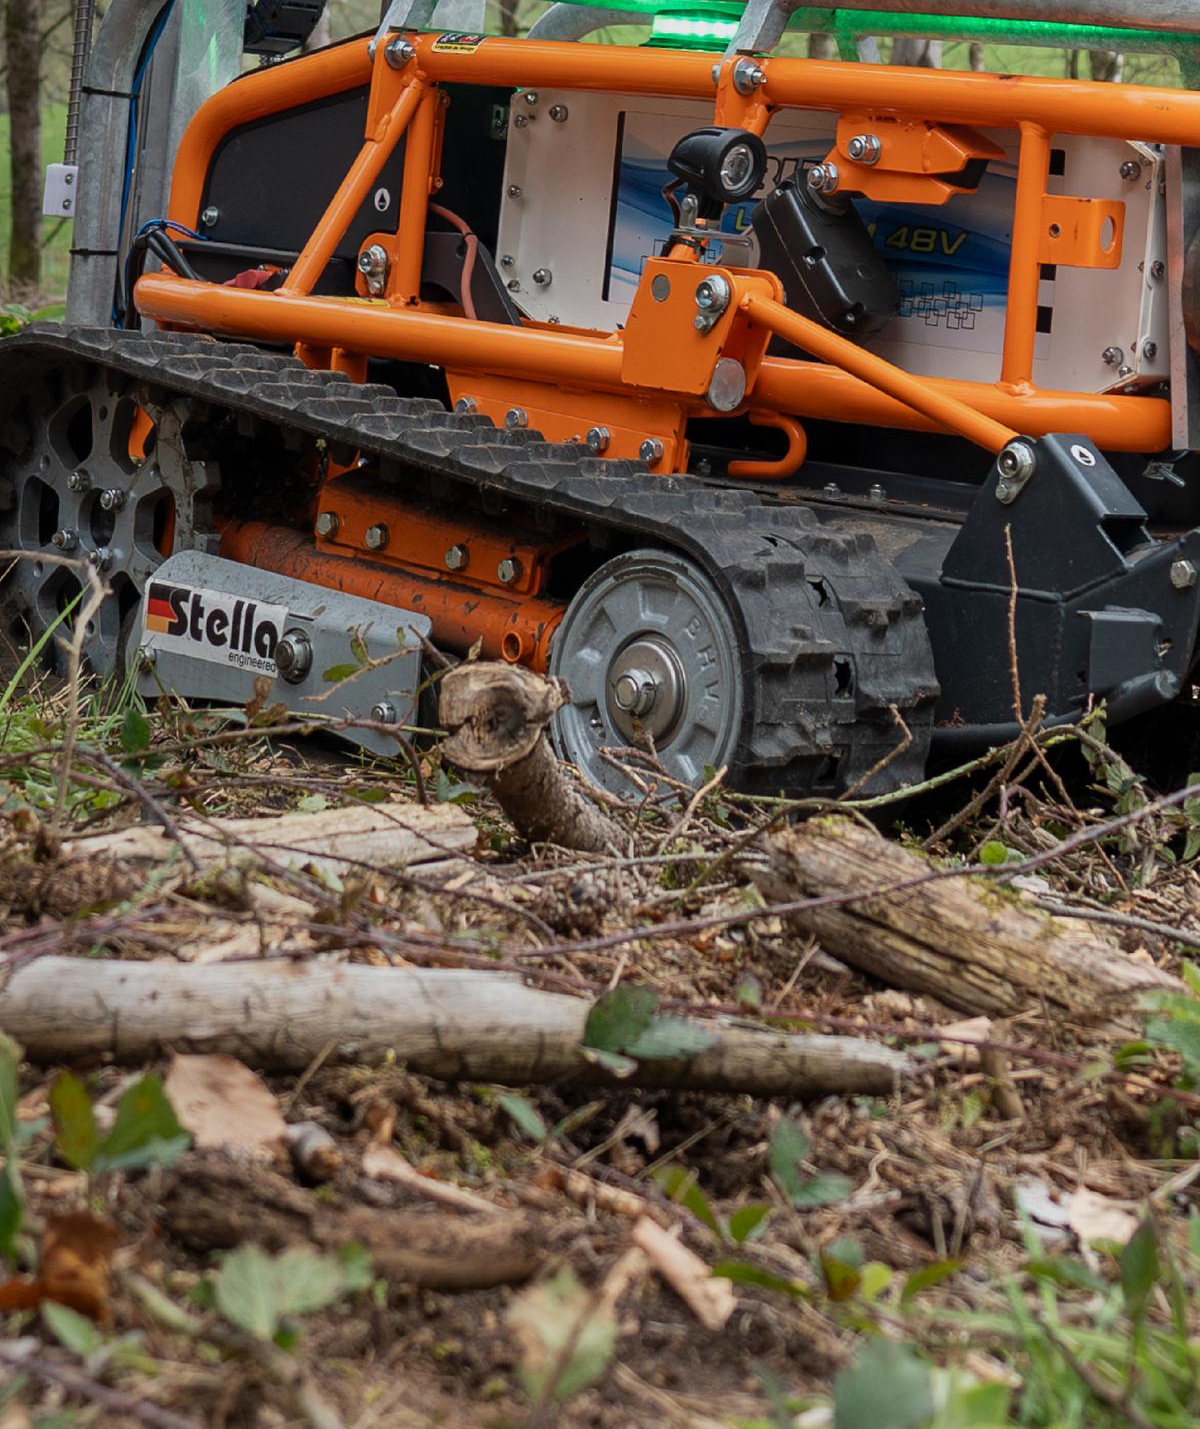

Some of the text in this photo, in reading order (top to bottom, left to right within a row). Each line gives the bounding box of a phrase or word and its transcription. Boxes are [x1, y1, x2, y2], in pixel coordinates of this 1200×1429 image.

[885, 225, 968, 256] 48V
[167, 587, 279, 660] Stella
[228, 652, 278, 673] engineered
